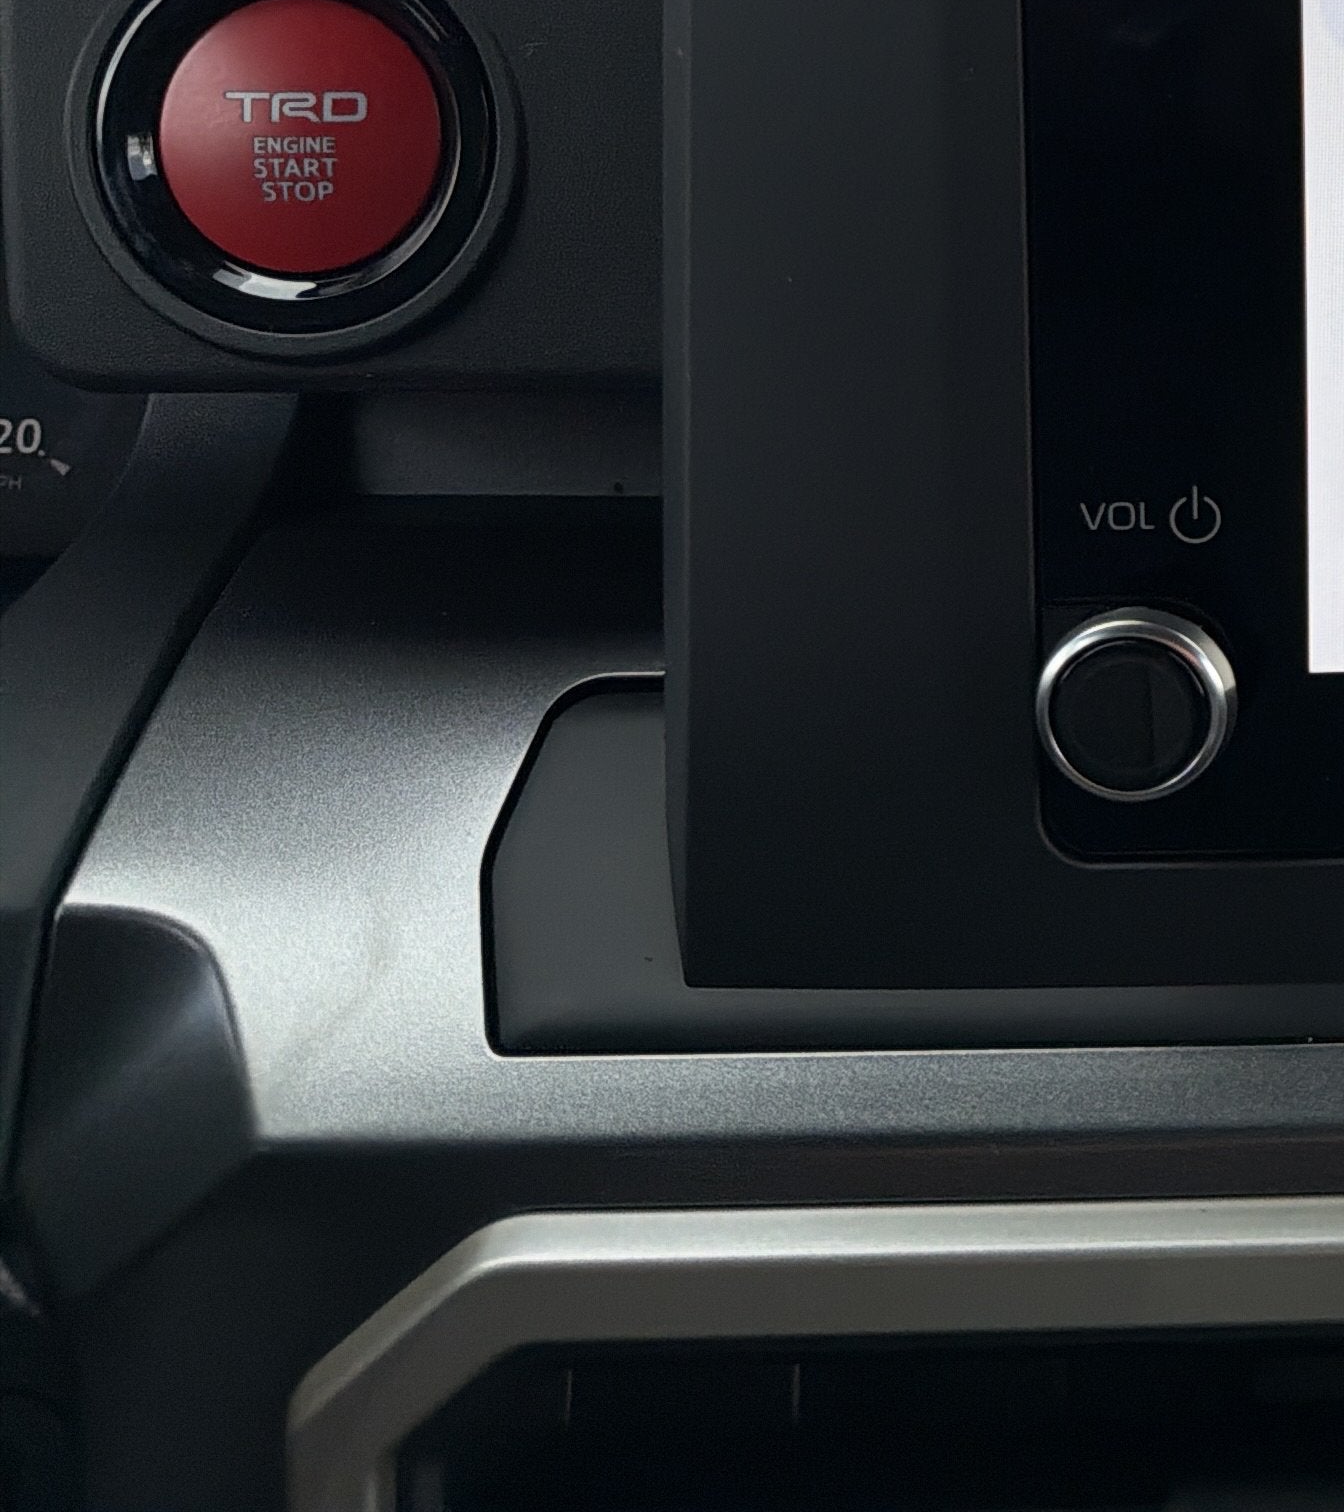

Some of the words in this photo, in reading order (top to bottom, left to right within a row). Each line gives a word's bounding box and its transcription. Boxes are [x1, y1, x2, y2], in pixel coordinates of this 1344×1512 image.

[225, 91, 366, 122] TRD
[254, 137, 335, 154] ENGINE
[254, 159, 335, 178] START
[263, 182, 334, 201] STOP
[1081, 502, 1155, 530] VOL
